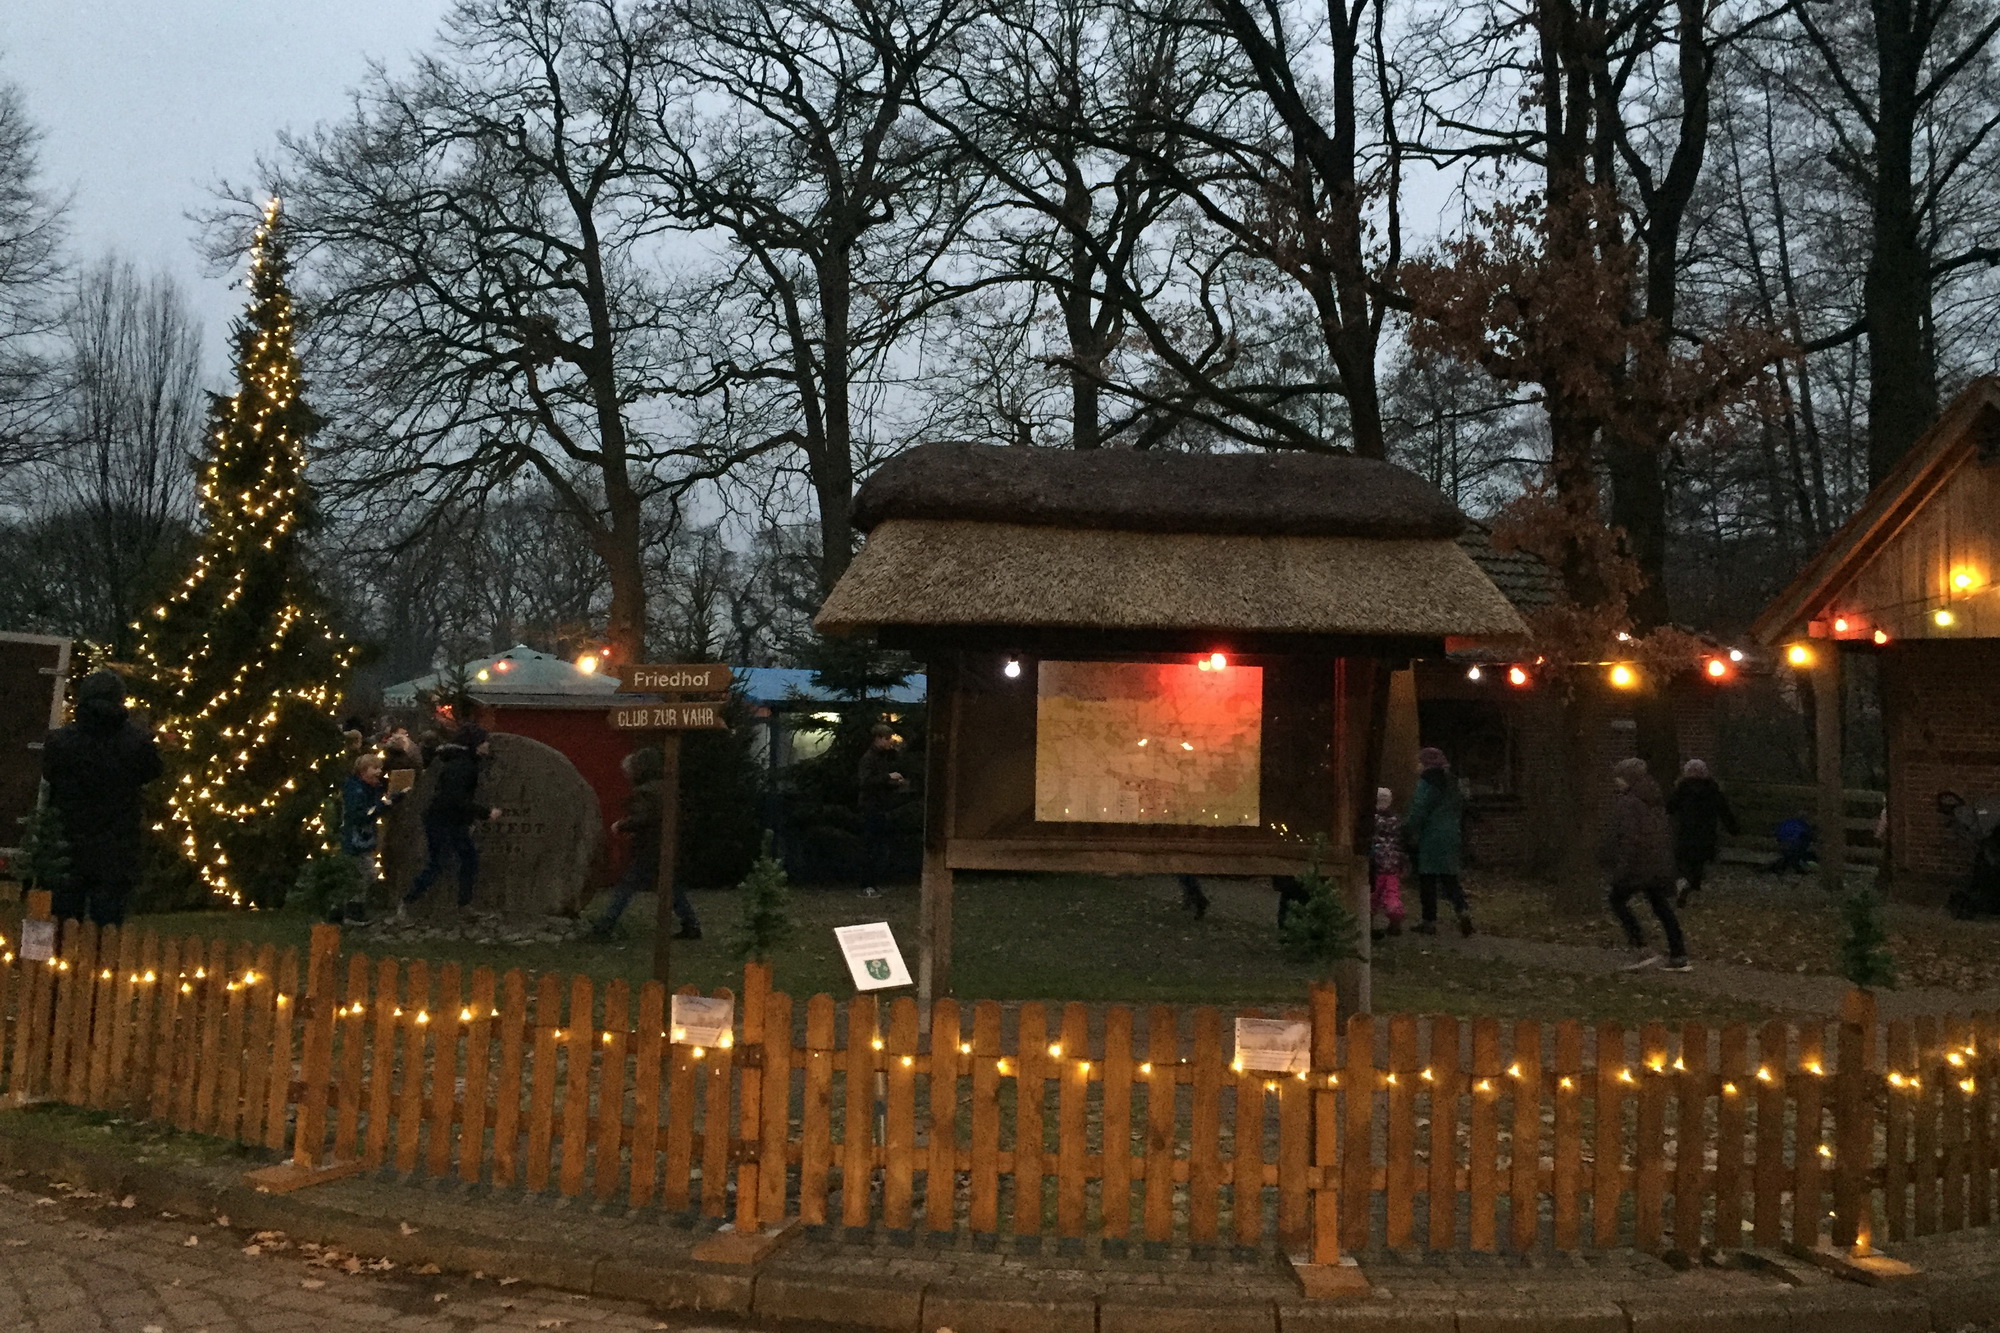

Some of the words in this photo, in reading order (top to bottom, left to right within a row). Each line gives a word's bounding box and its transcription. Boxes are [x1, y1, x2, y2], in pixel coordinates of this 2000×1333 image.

[633, 671, 711, 687] Friedhof
[617, 709, 648, 727] CLUB
[653, 708, 677, 726] ZUR
[682, 708, 714, 726] VAHR
